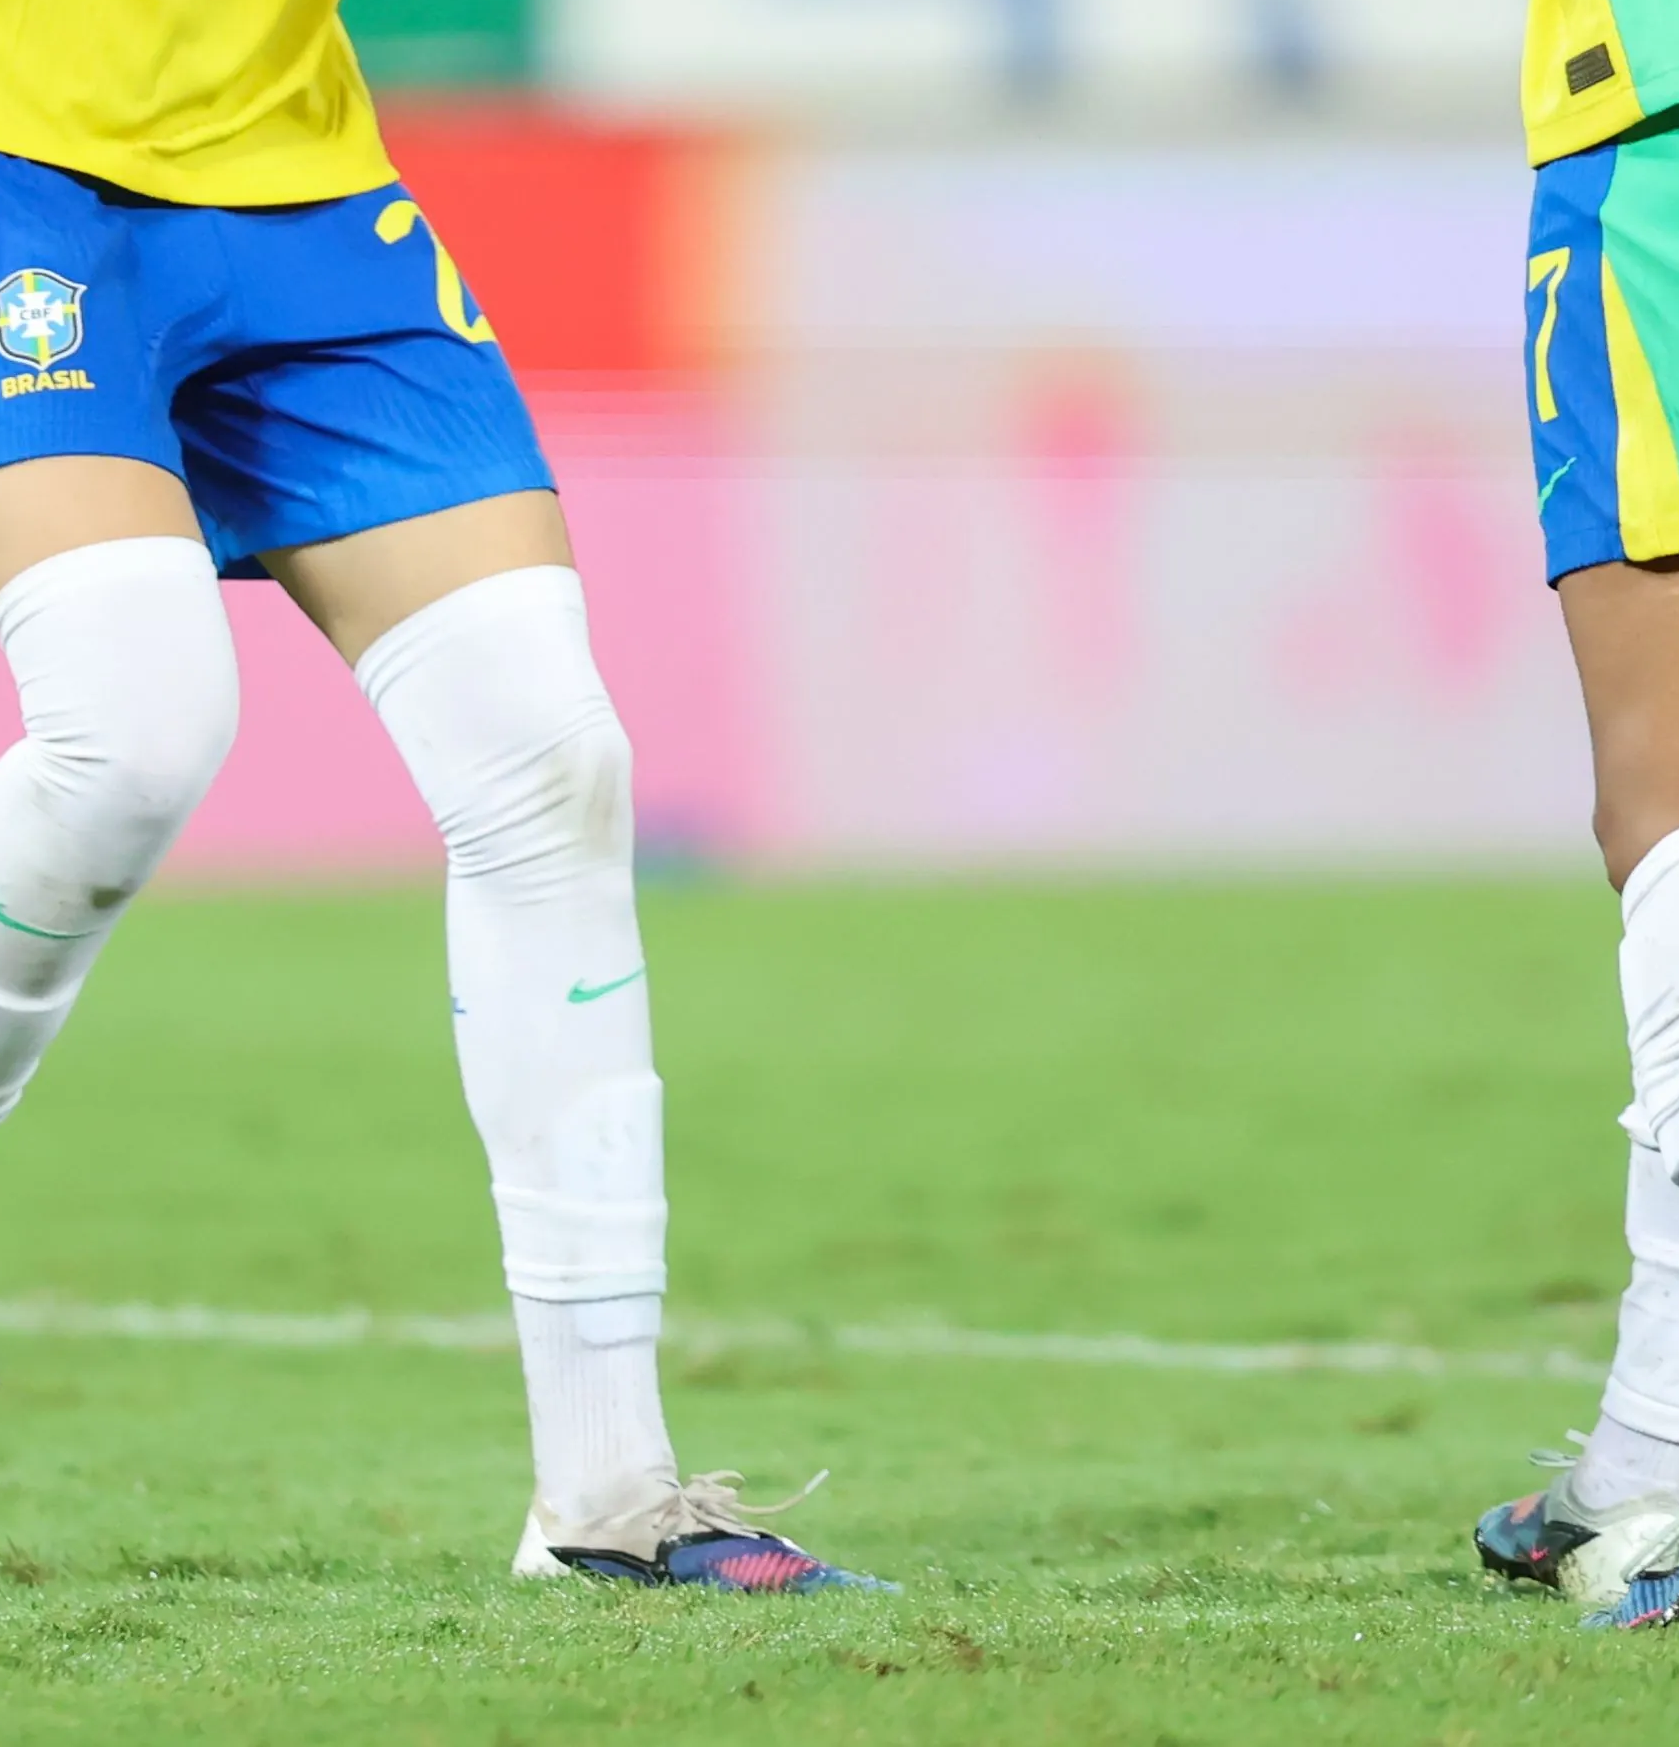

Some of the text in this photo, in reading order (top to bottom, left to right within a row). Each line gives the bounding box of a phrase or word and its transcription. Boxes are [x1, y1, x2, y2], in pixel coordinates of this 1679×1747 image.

[19, 307, 51, 321] CBF
[1528, 246, 1570, 424] 7
[0, 369, 96, 399] BRASIL
